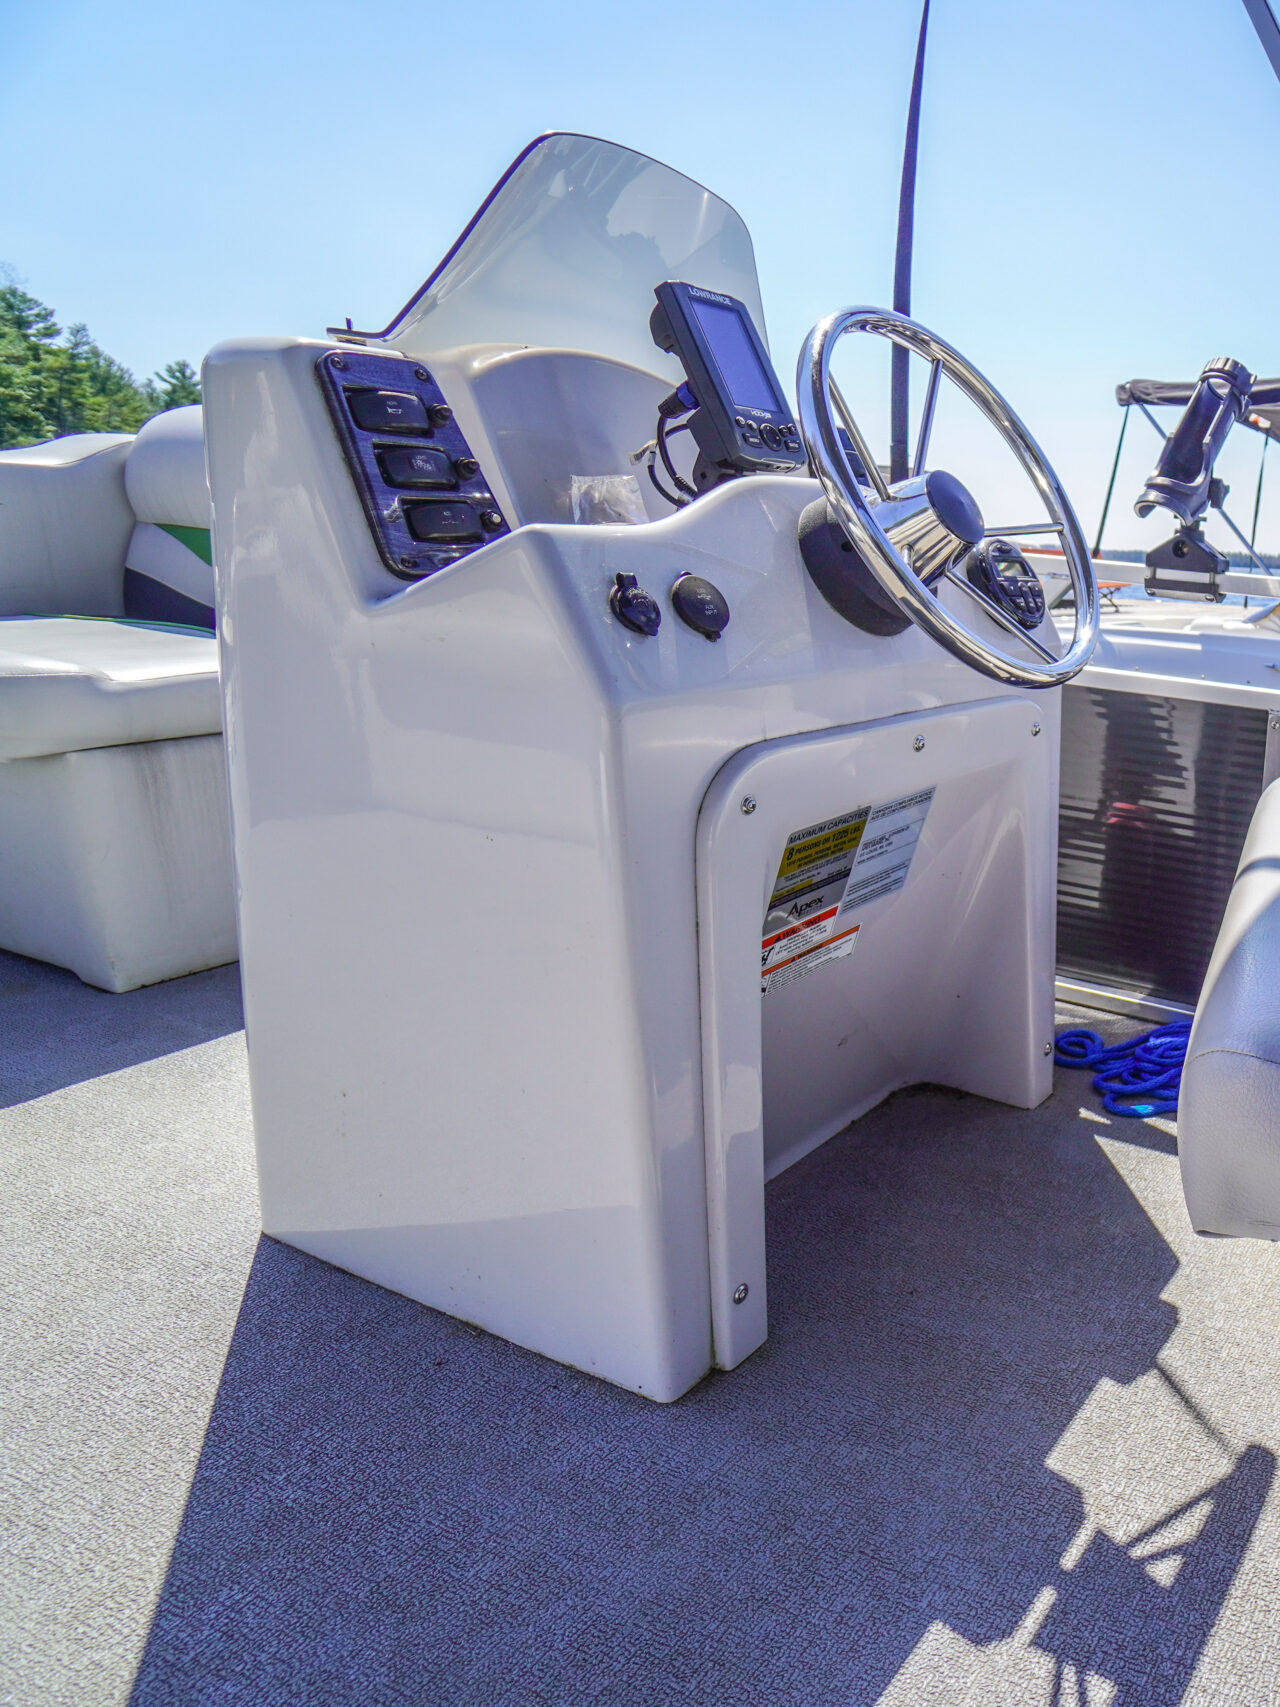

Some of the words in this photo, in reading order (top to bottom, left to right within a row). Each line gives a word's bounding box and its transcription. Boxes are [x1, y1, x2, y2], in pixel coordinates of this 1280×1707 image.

[688, 286, 732, 305] LOWRANCE
[788, 825, 827, 844] MAXIMUM
[827, 809, 870, 830] CAPACITIES
[787, 847, 795, 861] 8
[795, 840, 822, 855] PERSONS
[786, 895, 824, 919] Apex
